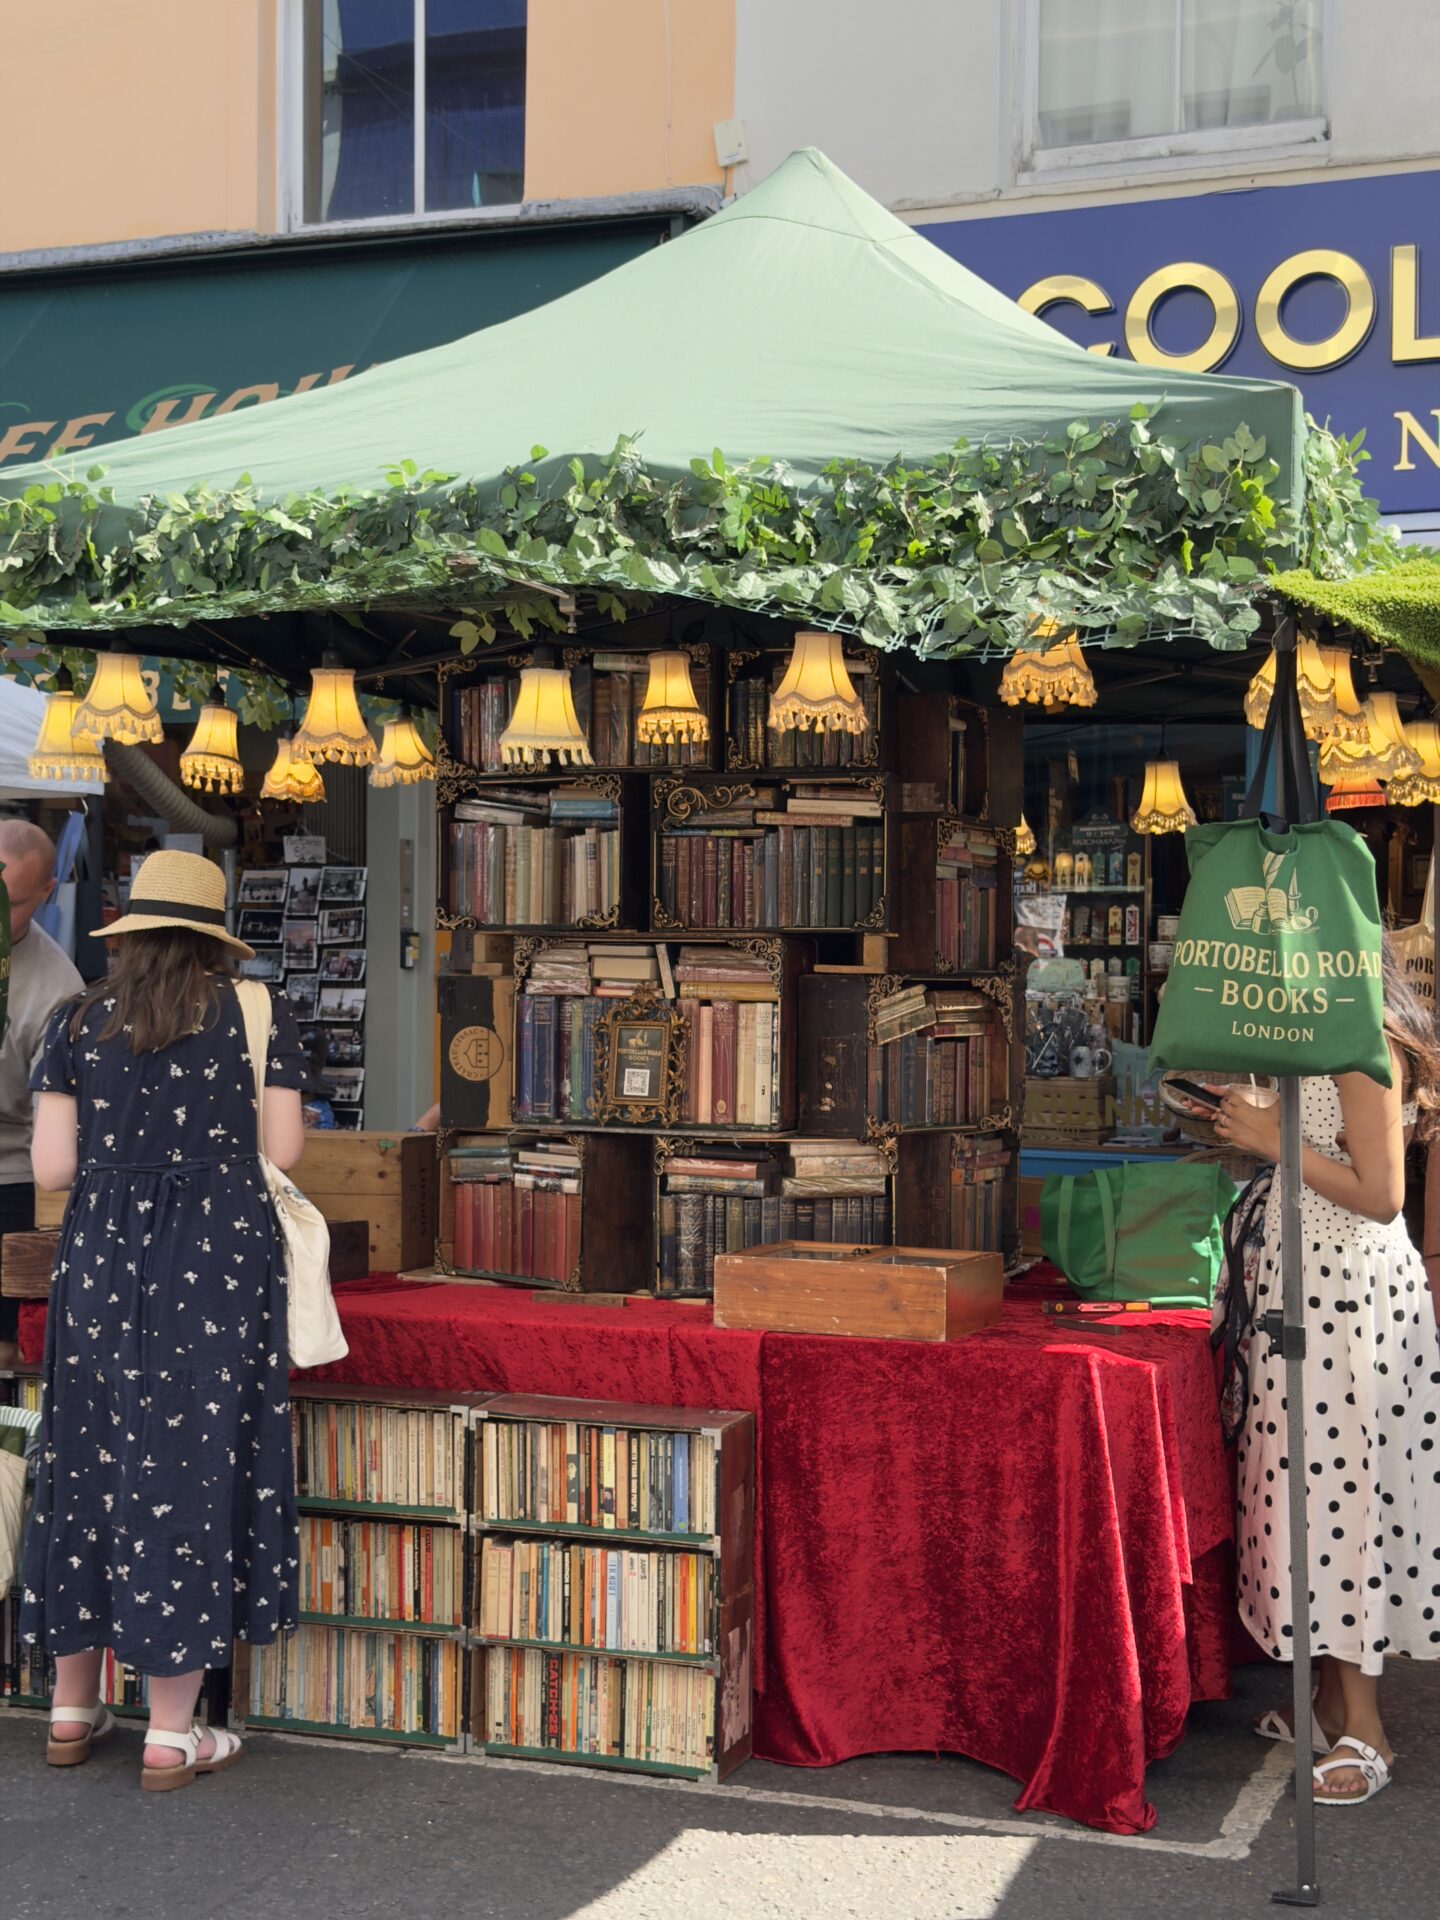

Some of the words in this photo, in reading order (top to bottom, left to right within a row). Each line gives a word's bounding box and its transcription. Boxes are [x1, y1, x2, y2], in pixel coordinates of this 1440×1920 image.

[1174, 939, 1310, 979] PORTOBELLO
[1220, 979, 1329, 1015] BOOKS
[1231, 1020, 1314, 1043] LONDON
[548, 1659, 559, 1735] CATCH-22
